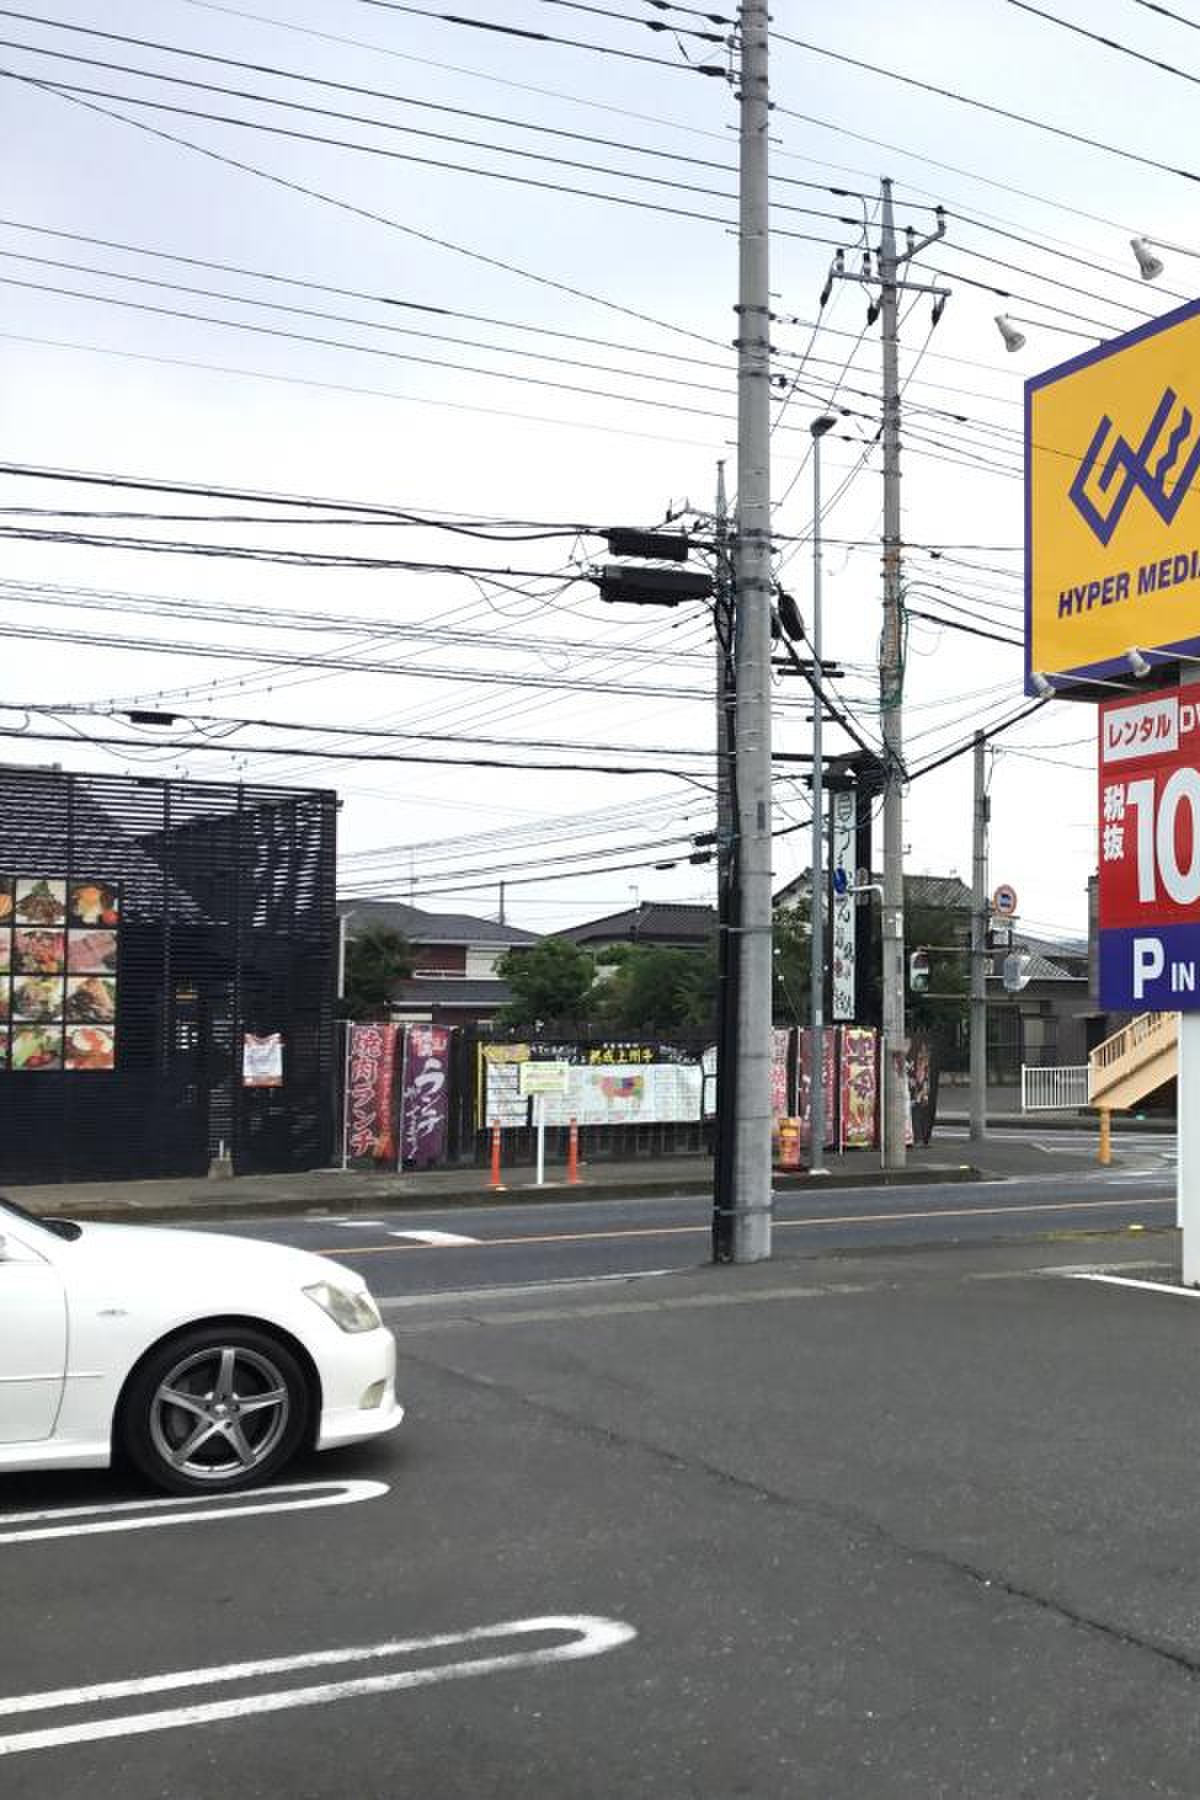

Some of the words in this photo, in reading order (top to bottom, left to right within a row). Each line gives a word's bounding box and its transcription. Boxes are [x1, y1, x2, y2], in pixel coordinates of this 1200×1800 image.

[1058, 571, 1130, 619] HYPER
[1109, 711, 1171, 748] レンタル
[1103, 783, 1125, 861] 税抜
[1133, 937, 1165, 1000] P
[1171, 962, 1196, 992] IN
